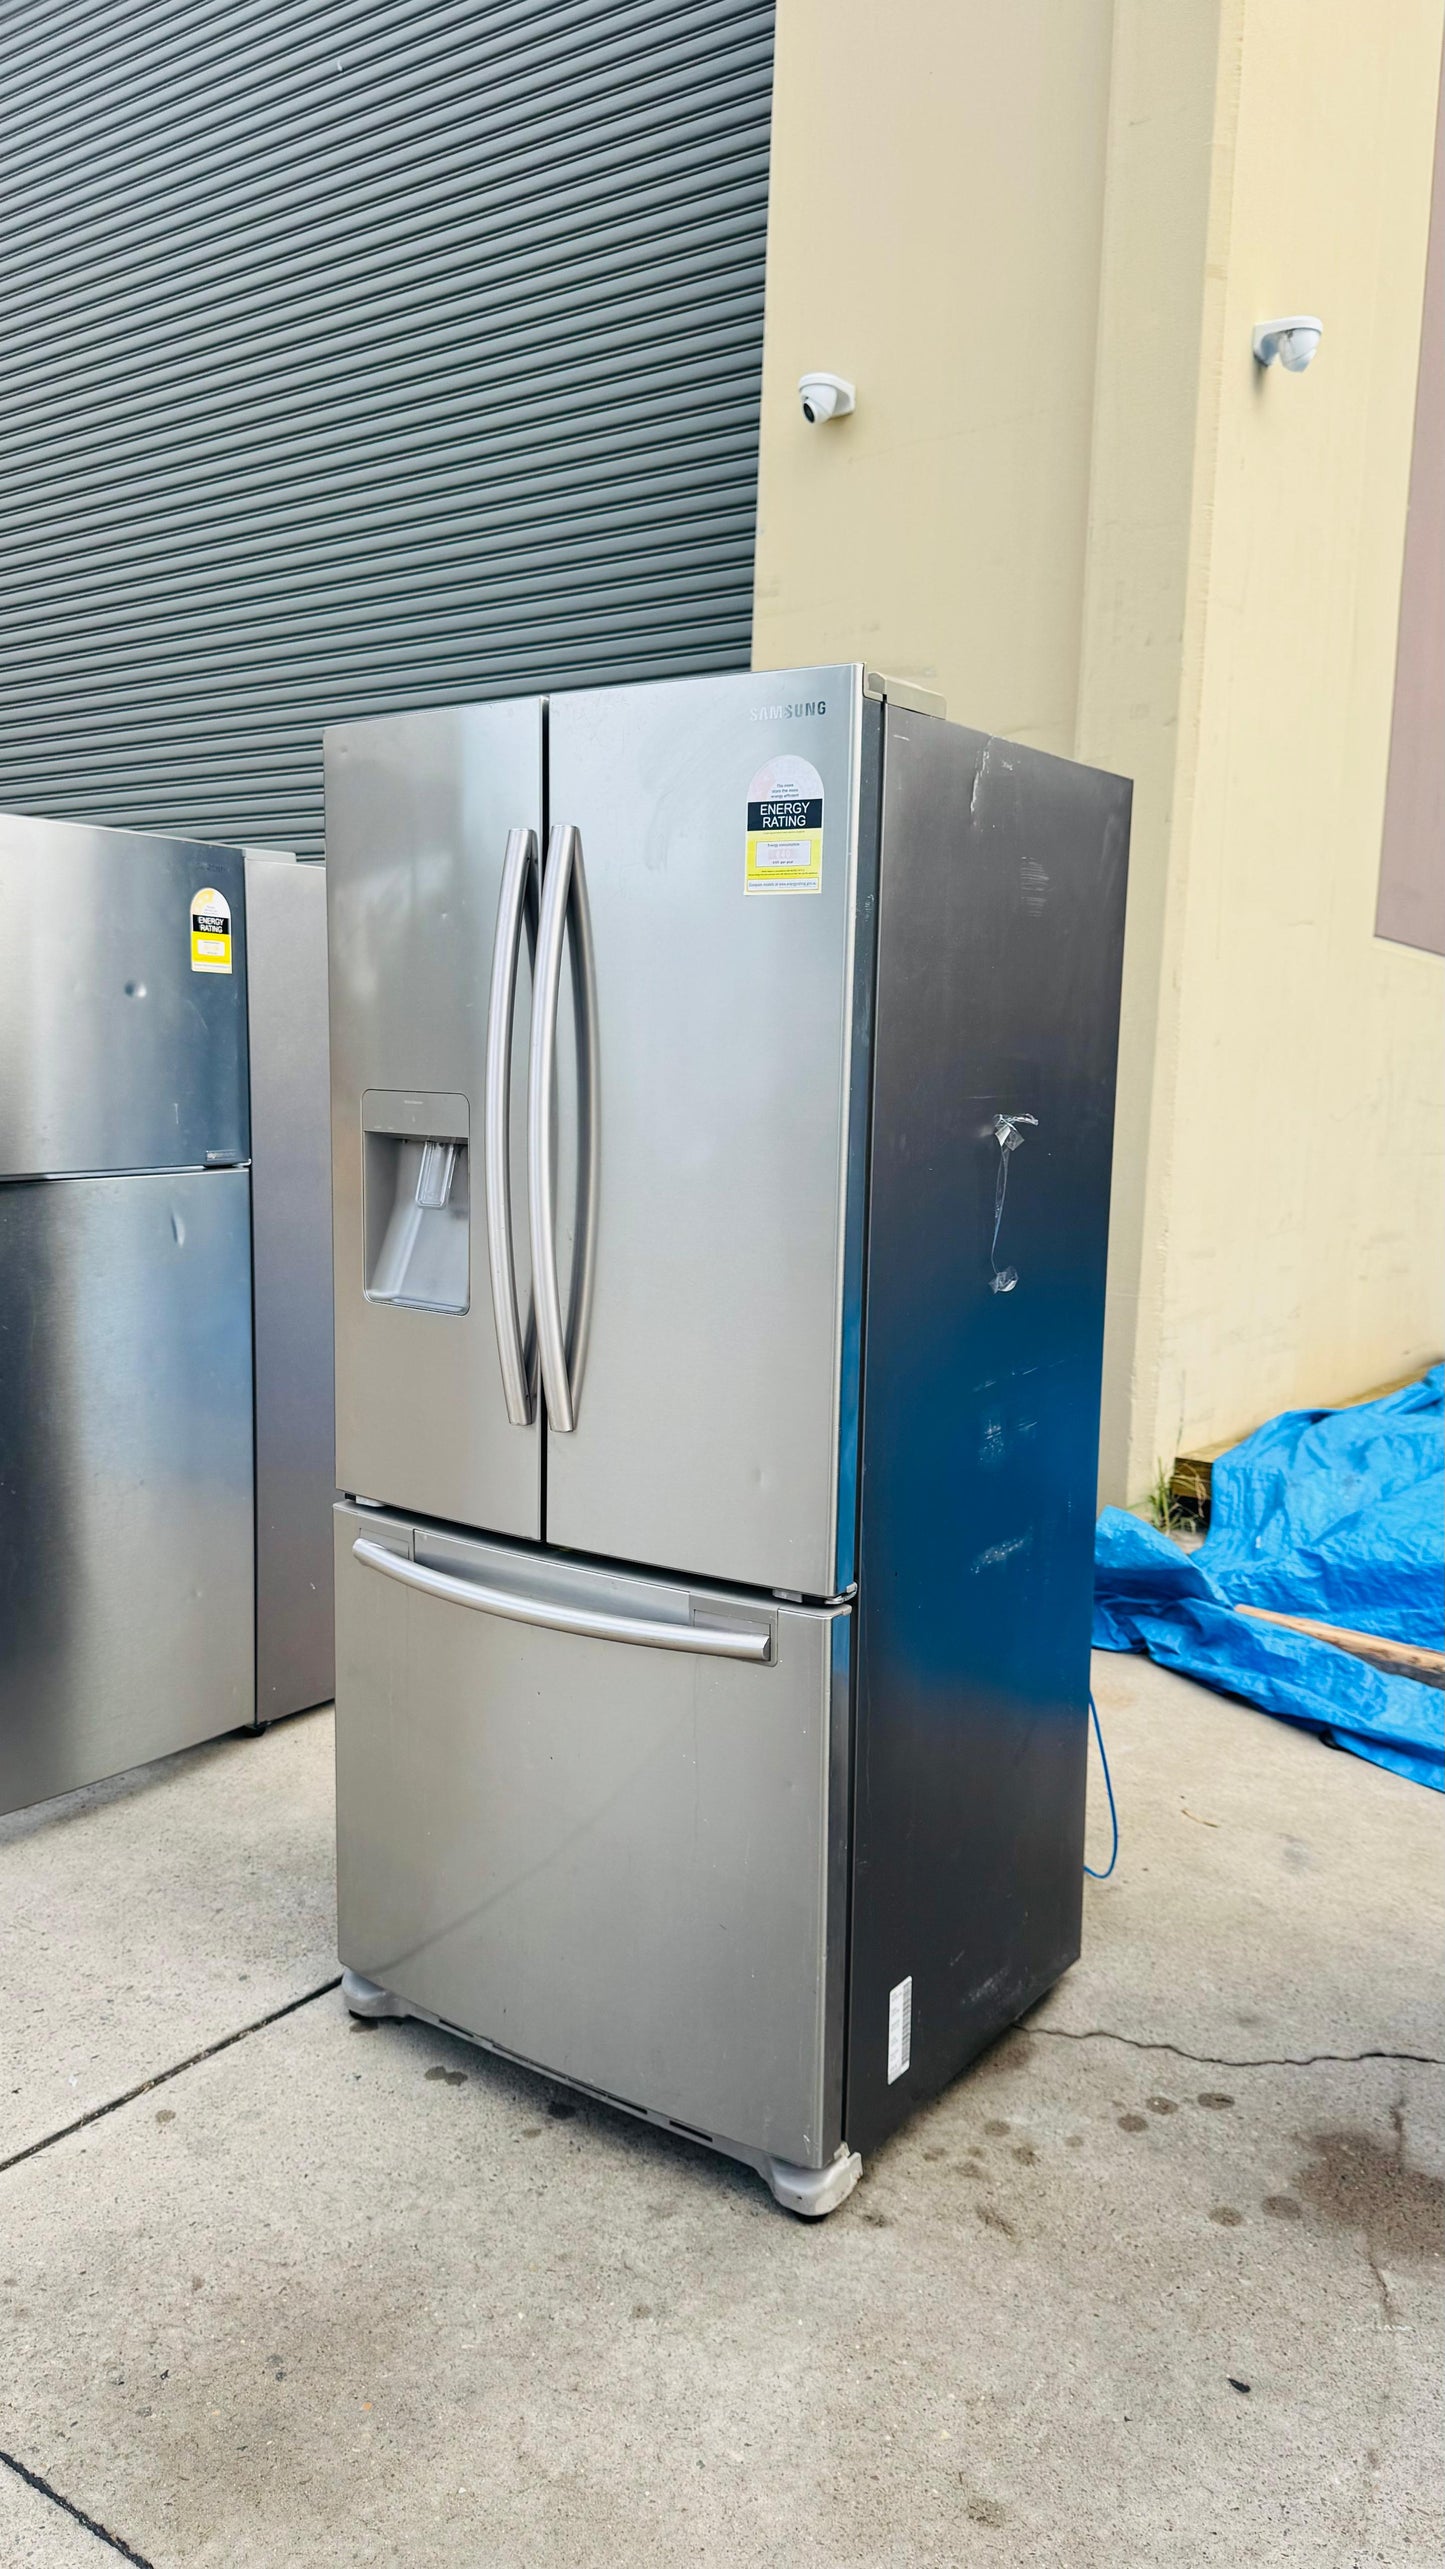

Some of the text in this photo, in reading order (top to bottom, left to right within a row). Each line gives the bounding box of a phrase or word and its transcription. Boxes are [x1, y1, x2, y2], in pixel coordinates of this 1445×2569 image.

[750, 701, 826, 721] SAMSUNG
[760, 801, 810, 816] ENERGY
[762, 815, 806, 828] RATING
[198, 916, 224, 926] ENERGY
[199, 925, 223, 934] RATING
